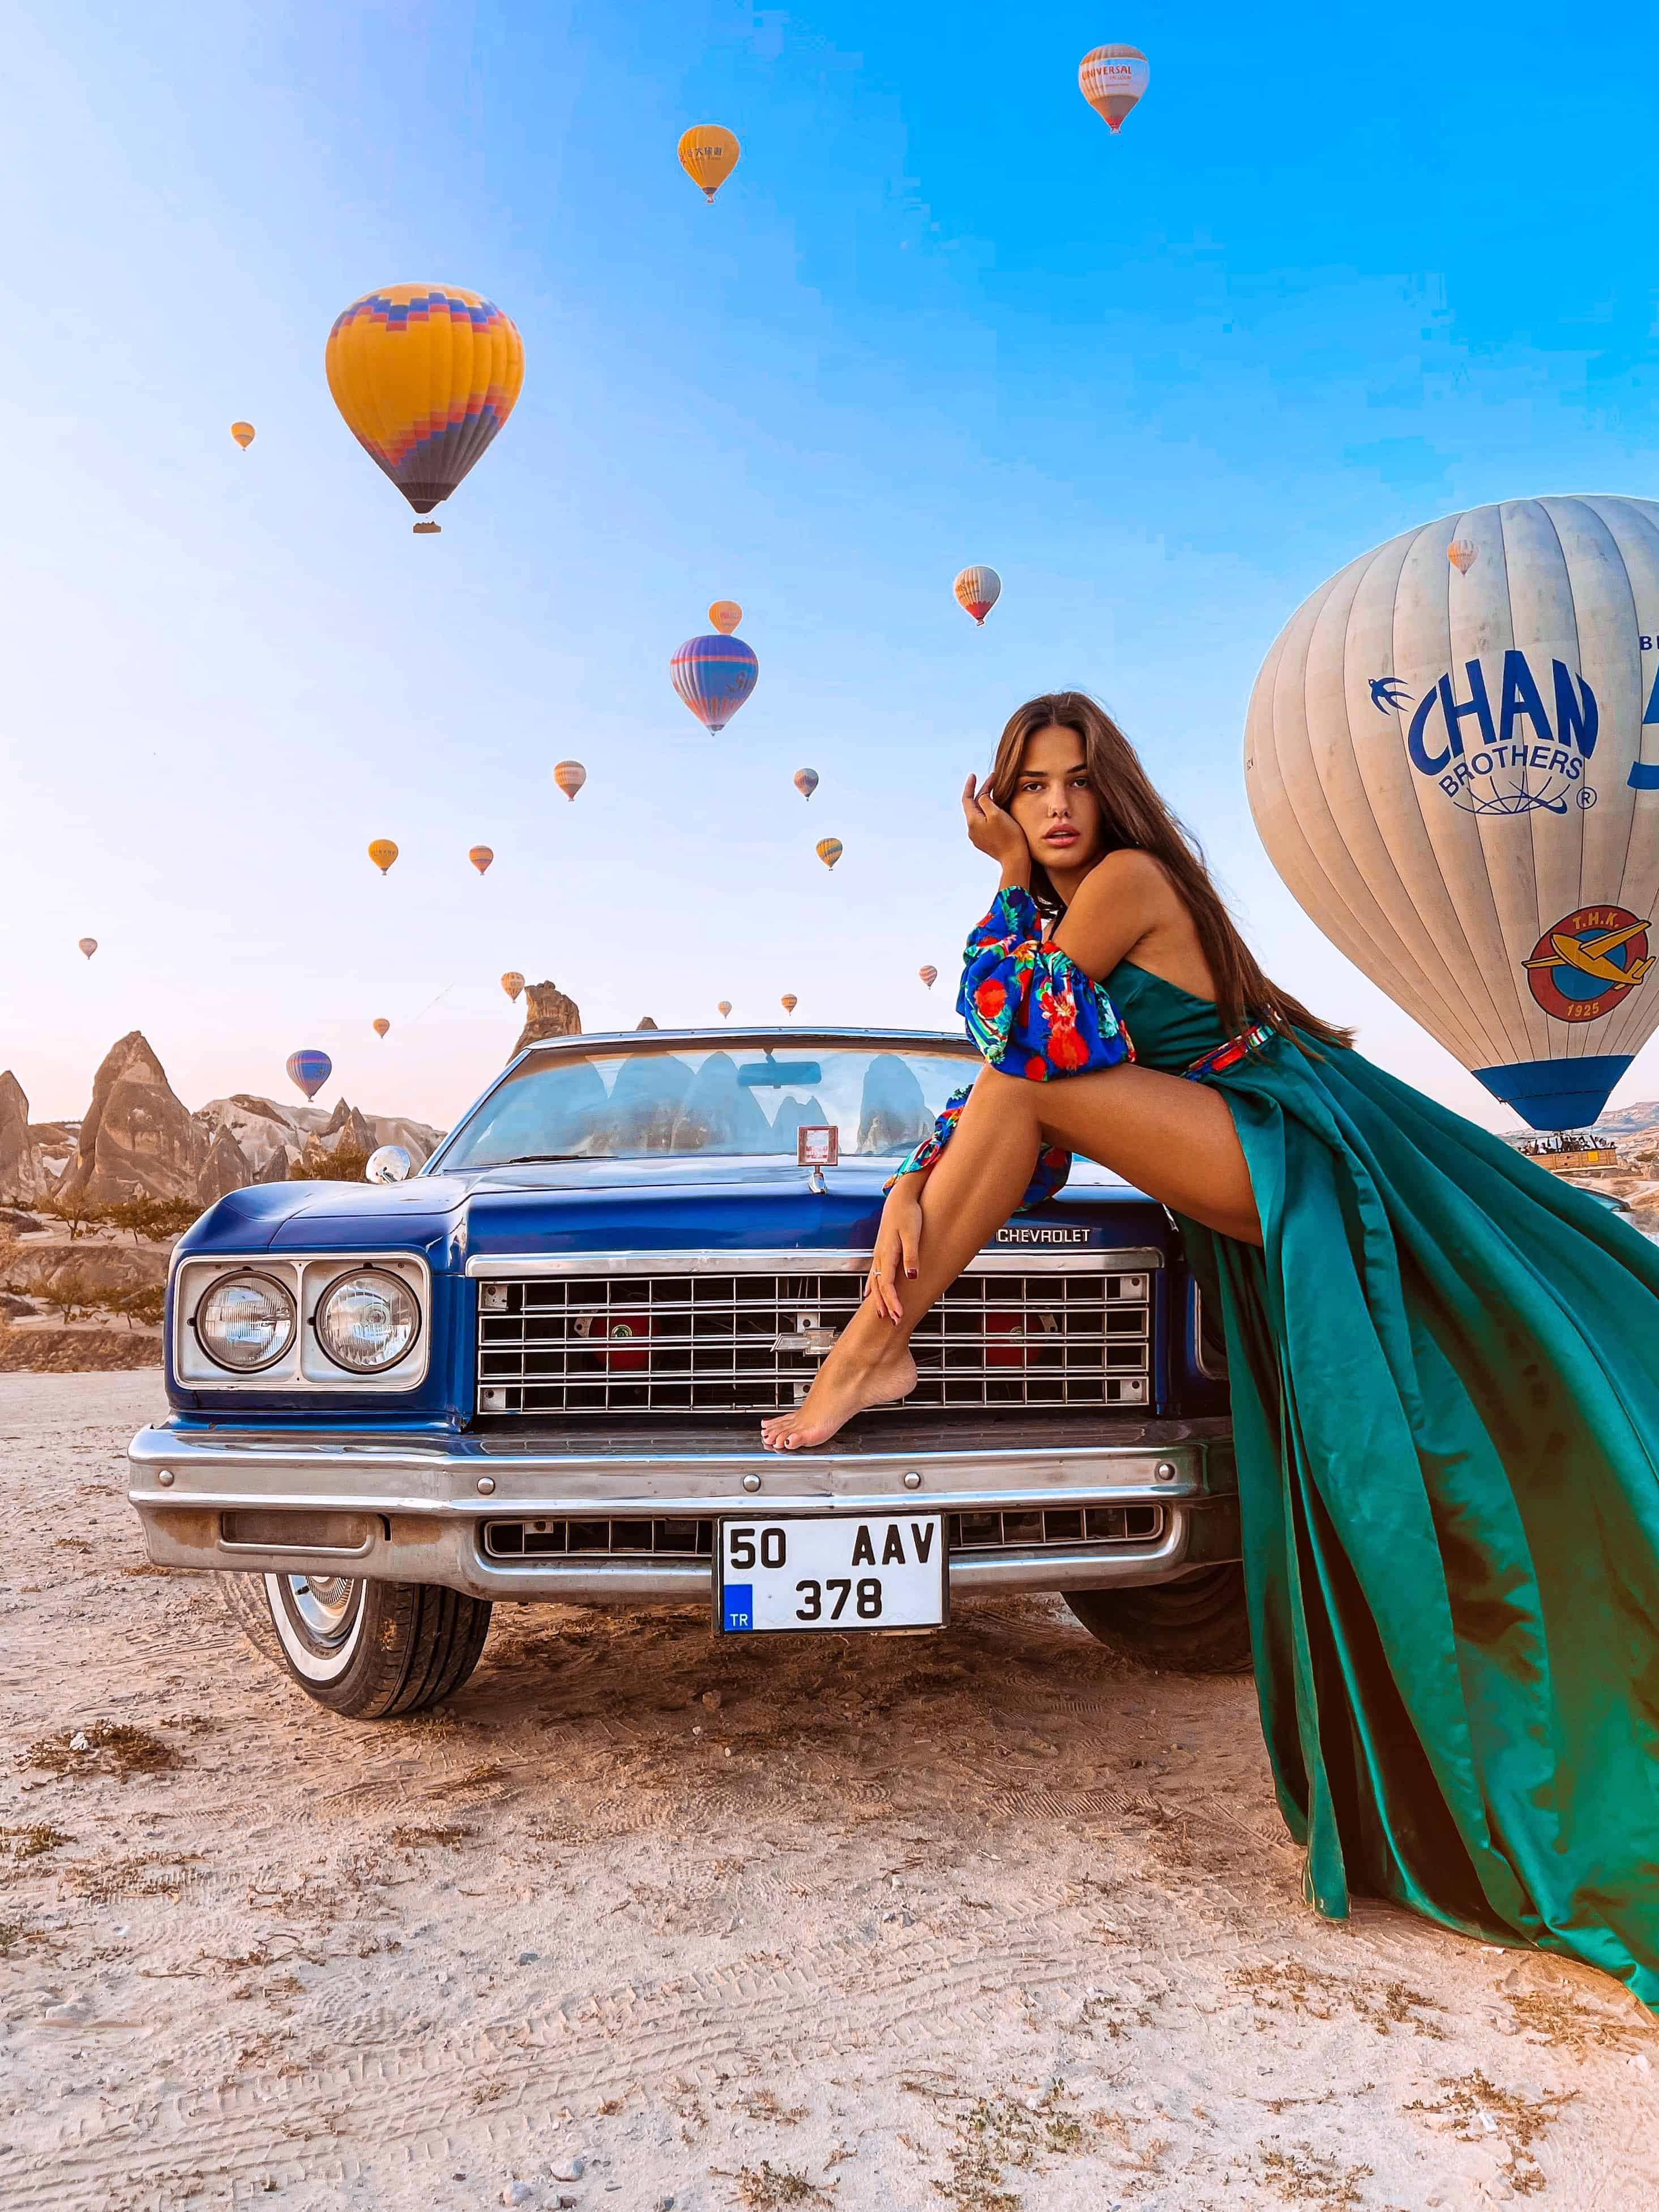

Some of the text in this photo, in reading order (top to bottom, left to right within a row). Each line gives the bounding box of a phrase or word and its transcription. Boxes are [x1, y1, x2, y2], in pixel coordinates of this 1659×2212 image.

[1082, 65, 1132, 80] UNIVERSAL
[1408, 650, 1598, 776] CHAN
[1438, 745, 1583, 798] BROTHERS
[1572, 912, 1619, 930] T.H.K.
[1567, 1002, 1600, 1017] 1925
[997, 1229, 1091, 1243] CHEVROLET
[730, 1522, 935, 1569] 50 AAV
[796, 1578, 883, 1621] 378
[729, 1614, 748, 1627] TR
